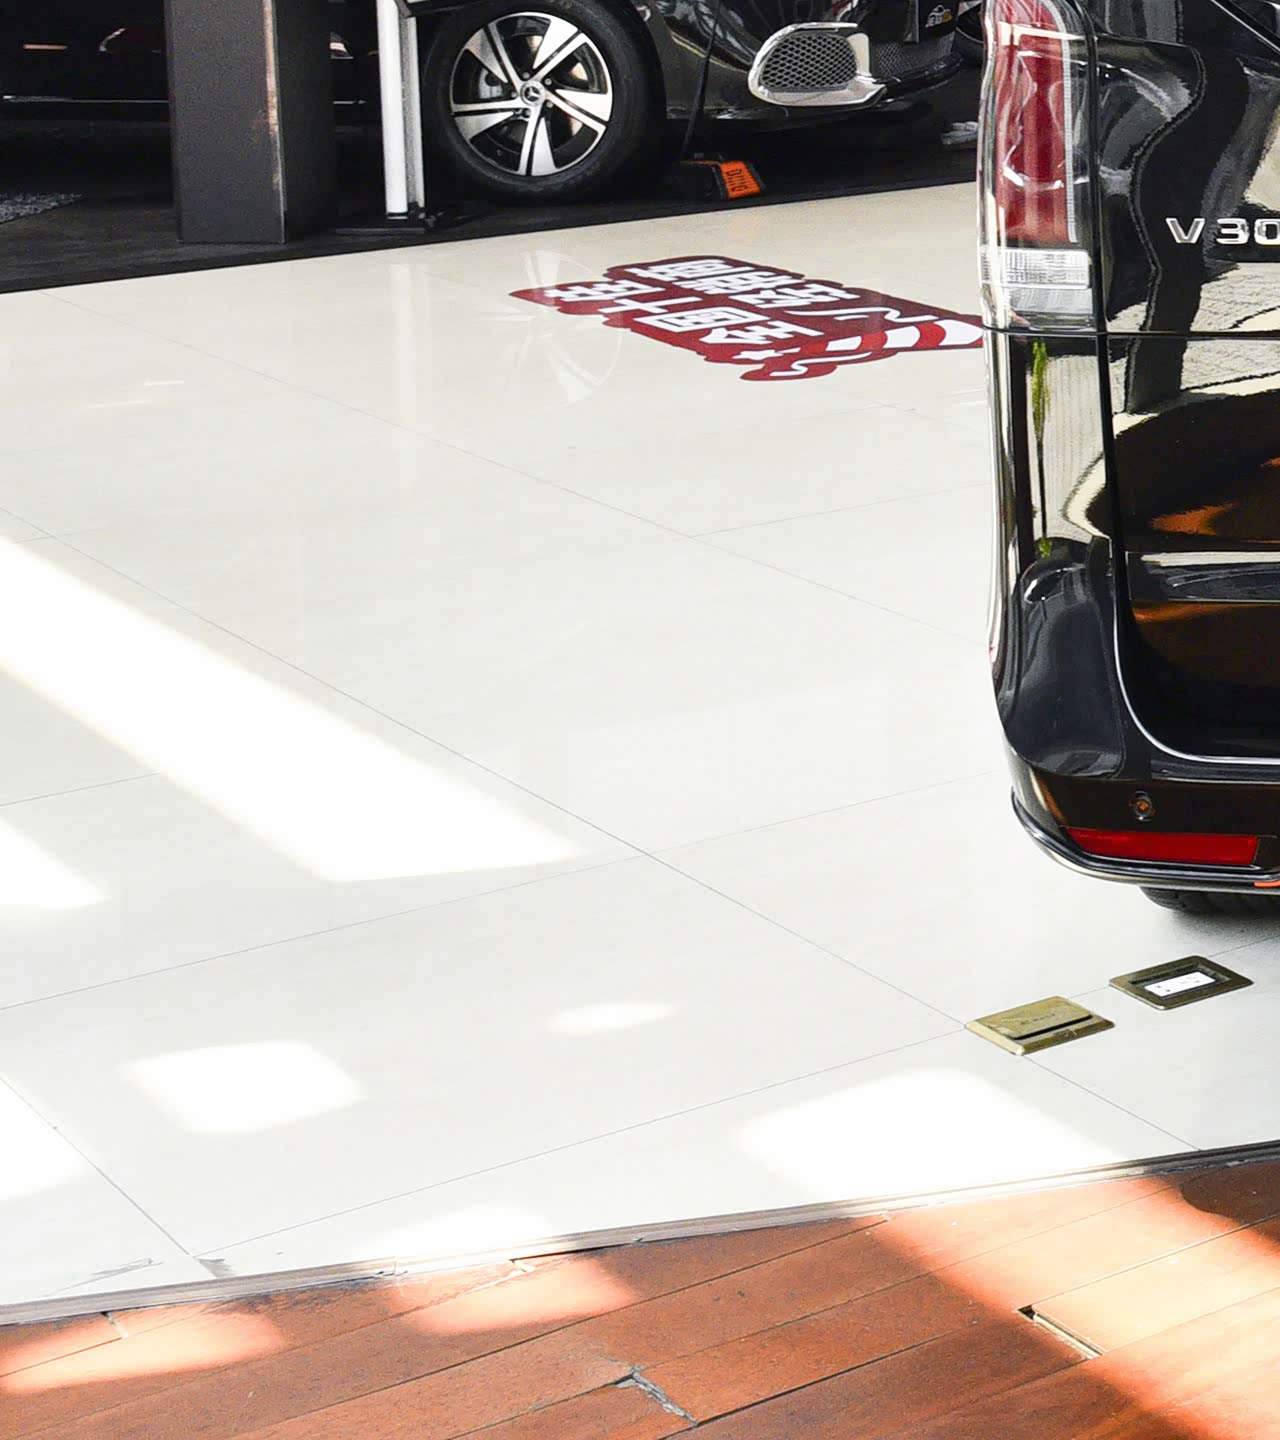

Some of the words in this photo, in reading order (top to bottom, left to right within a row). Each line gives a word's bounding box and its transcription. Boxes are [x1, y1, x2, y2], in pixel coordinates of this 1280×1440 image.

[544, 279, 824, 346] 全国十佳
[624, 259, 861, 308] 经销商
